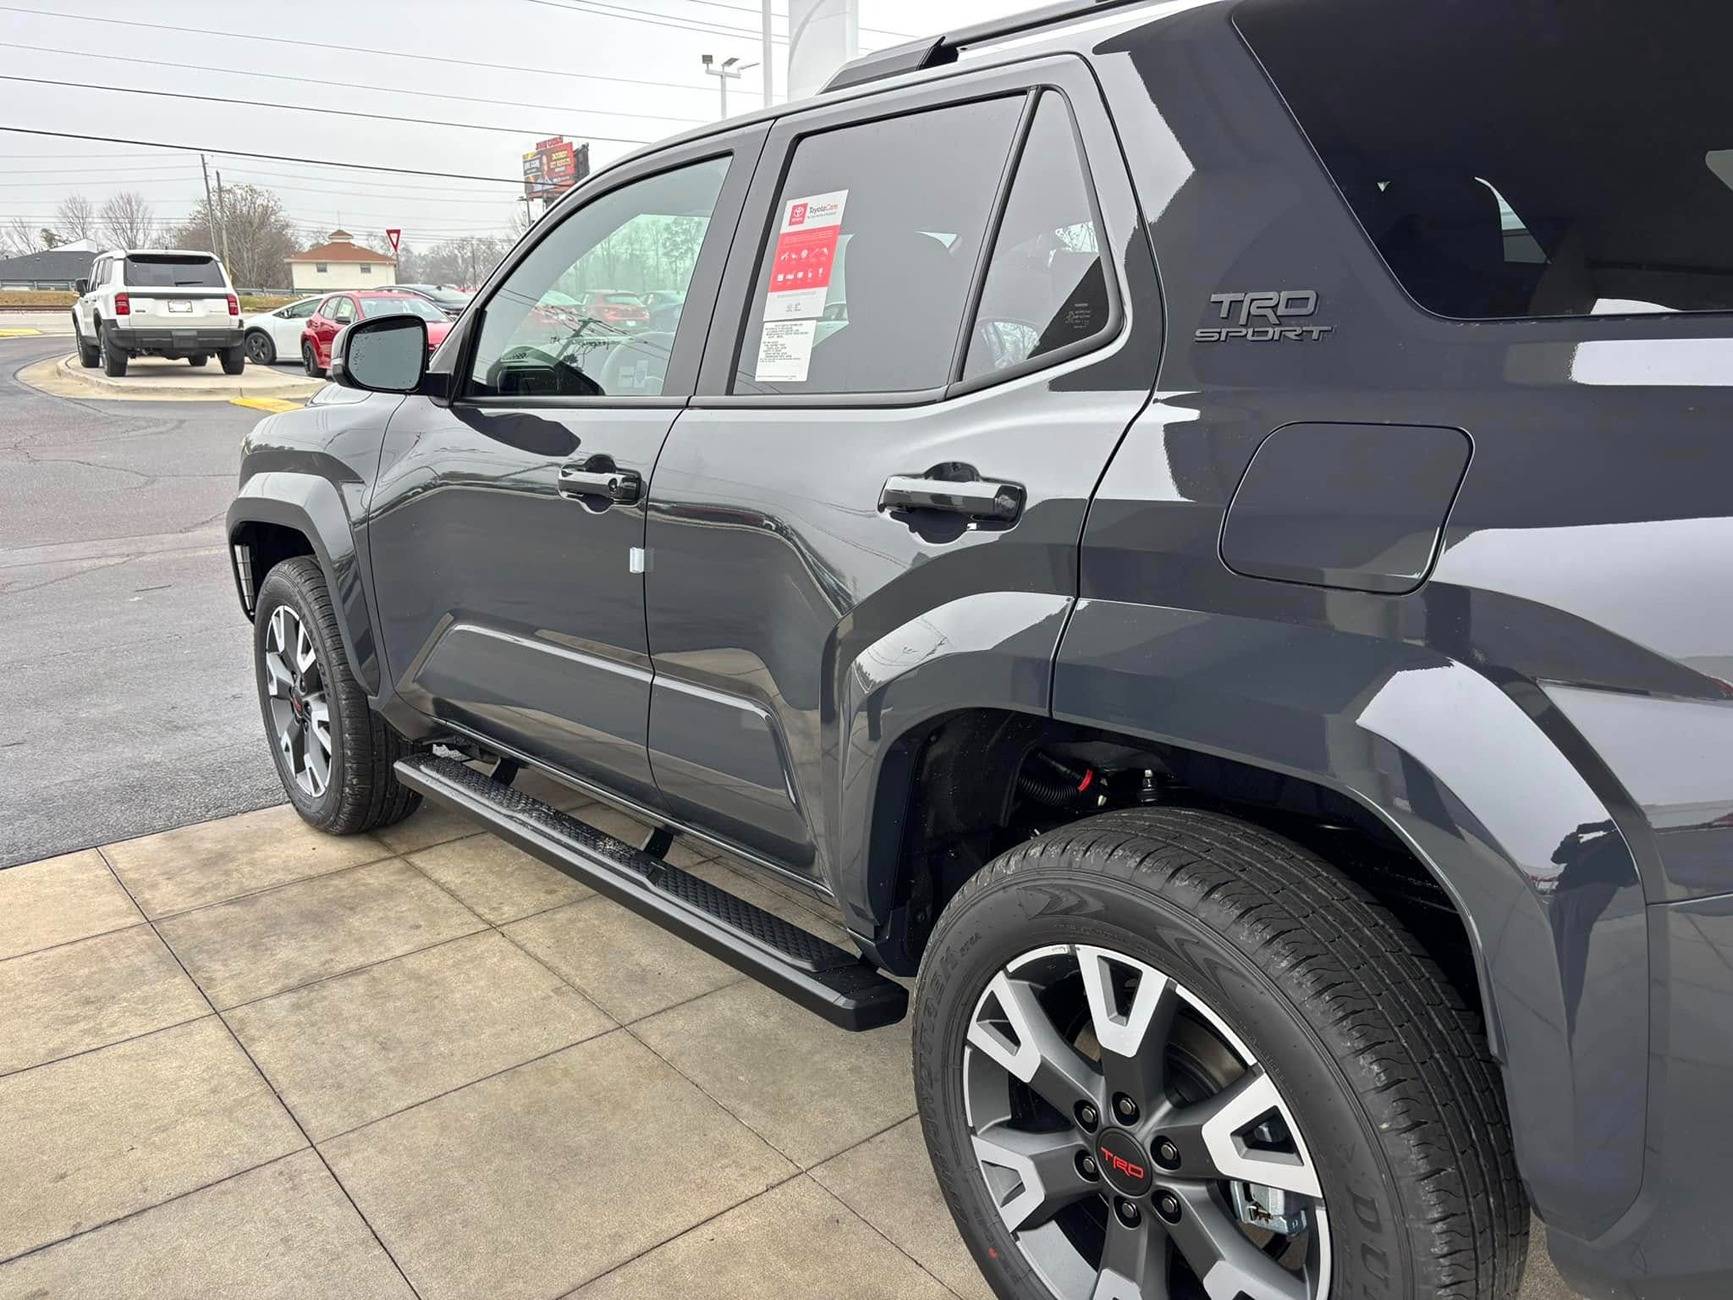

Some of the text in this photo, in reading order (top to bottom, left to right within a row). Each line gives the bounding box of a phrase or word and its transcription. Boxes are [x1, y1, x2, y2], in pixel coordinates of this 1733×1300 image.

[1210, 290, 1319, 326] TRD
[1194, 326, 1332, 343] SPORT
[1101, 1146, 1144, 1179] TRD
